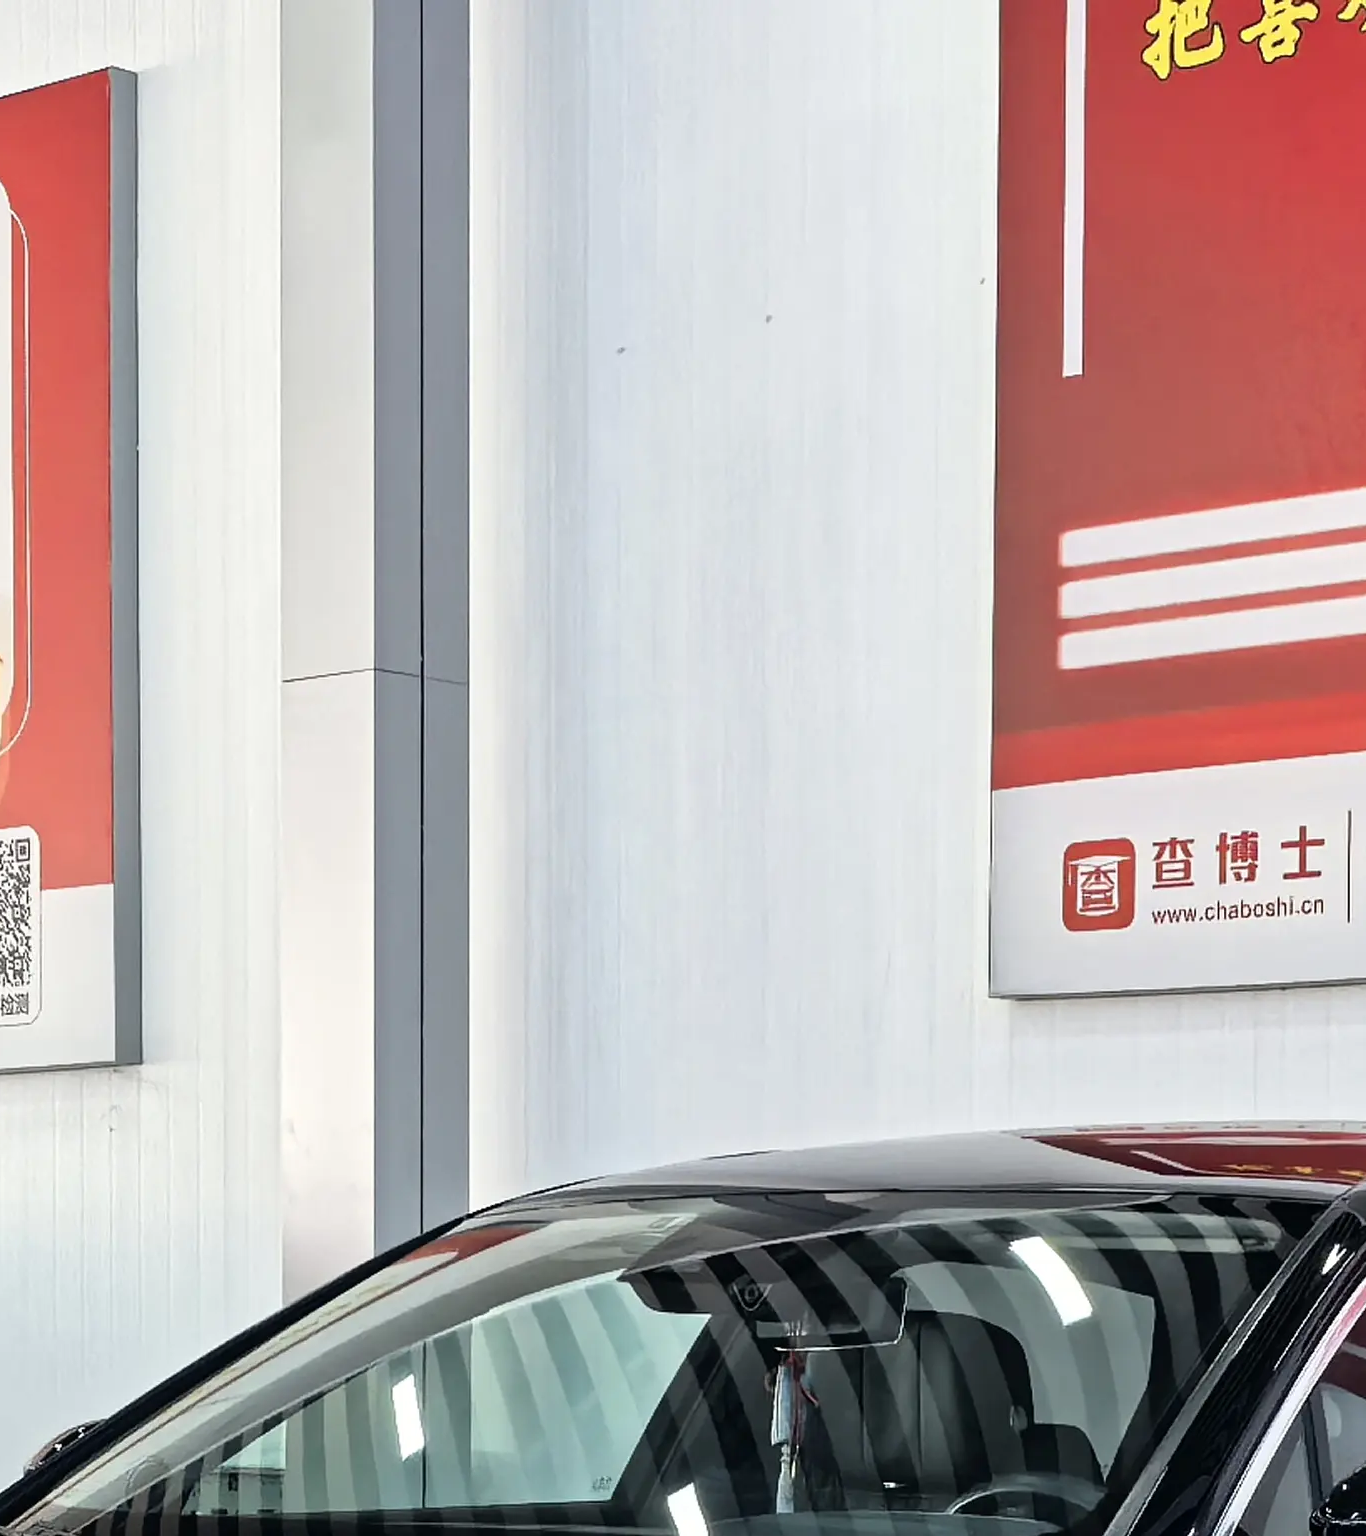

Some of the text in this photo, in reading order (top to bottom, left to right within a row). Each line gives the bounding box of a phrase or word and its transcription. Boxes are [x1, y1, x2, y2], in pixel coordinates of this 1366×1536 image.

[1151, 824, 1326, 890] 查博士
[1151, 894, 1325, 926] www.chaboshi.cn
